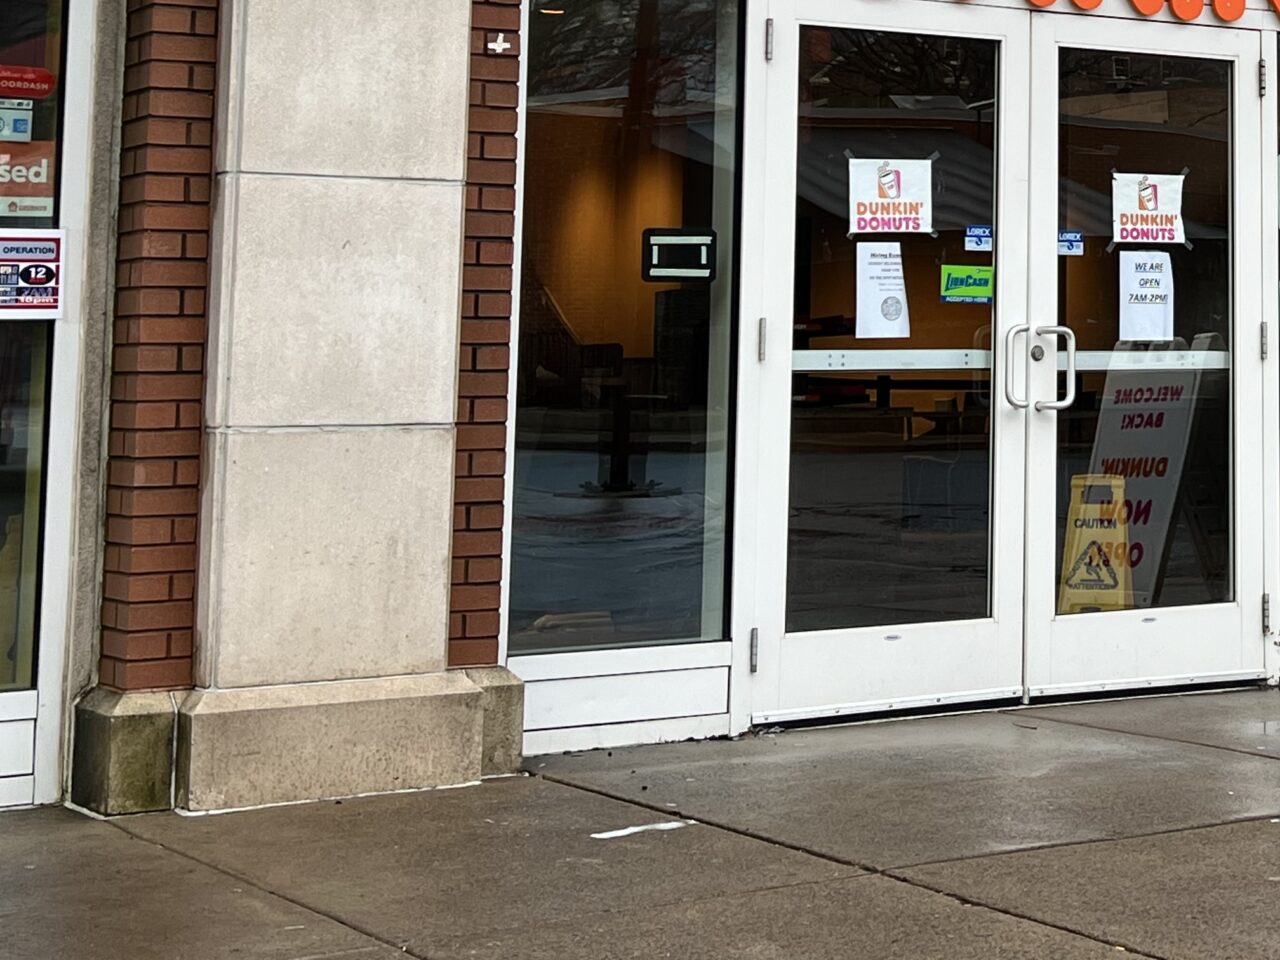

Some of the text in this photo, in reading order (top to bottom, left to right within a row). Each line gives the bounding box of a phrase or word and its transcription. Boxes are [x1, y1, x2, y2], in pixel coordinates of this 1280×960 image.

[857, 202, 923, 215] DUNKIN'
[857, 216, 921, 230] DONUTS
[1120, 213, 1178, 227] DUNKIN'
[966, 227, 990, 236] LOREX
[1120, 227, 1175, 241] DONUTS
[3, 246, 55, 254] OPERATION
[1135, 262, 1164, 272] WE ARE
[29, 267, 47, 279] 12
[1139, 278, 1160, 287] OPEN
[1074, 518, 1117, 529] CAUTION
